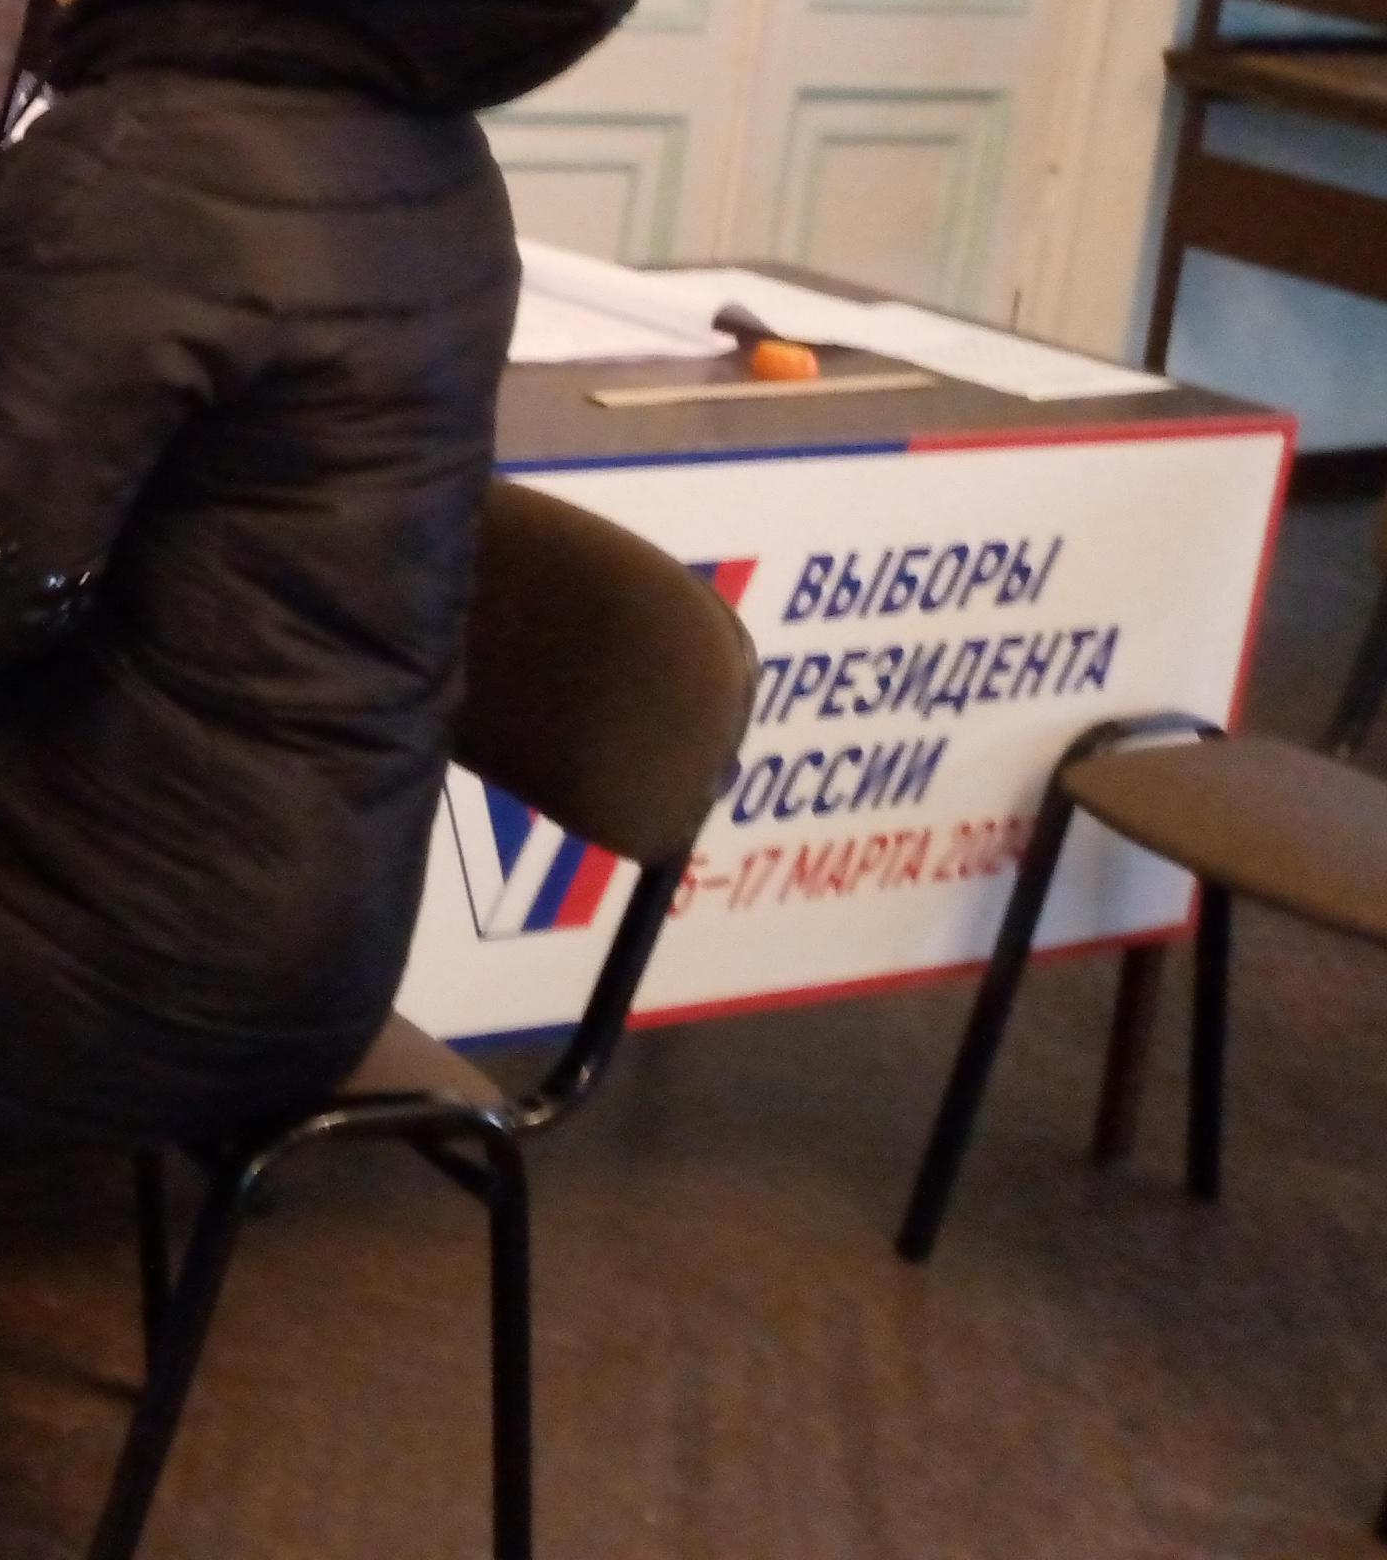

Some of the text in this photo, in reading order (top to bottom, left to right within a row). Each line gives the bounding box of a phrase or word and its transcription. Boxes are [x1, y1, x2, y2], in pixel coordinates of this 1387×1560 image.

[782, 536, 1064, 626] ВЫБОРЫ
[753, 625, 1120, 726] ПРЕЗИДЕНТА
[777, 828, 932, 906] МАРТА
